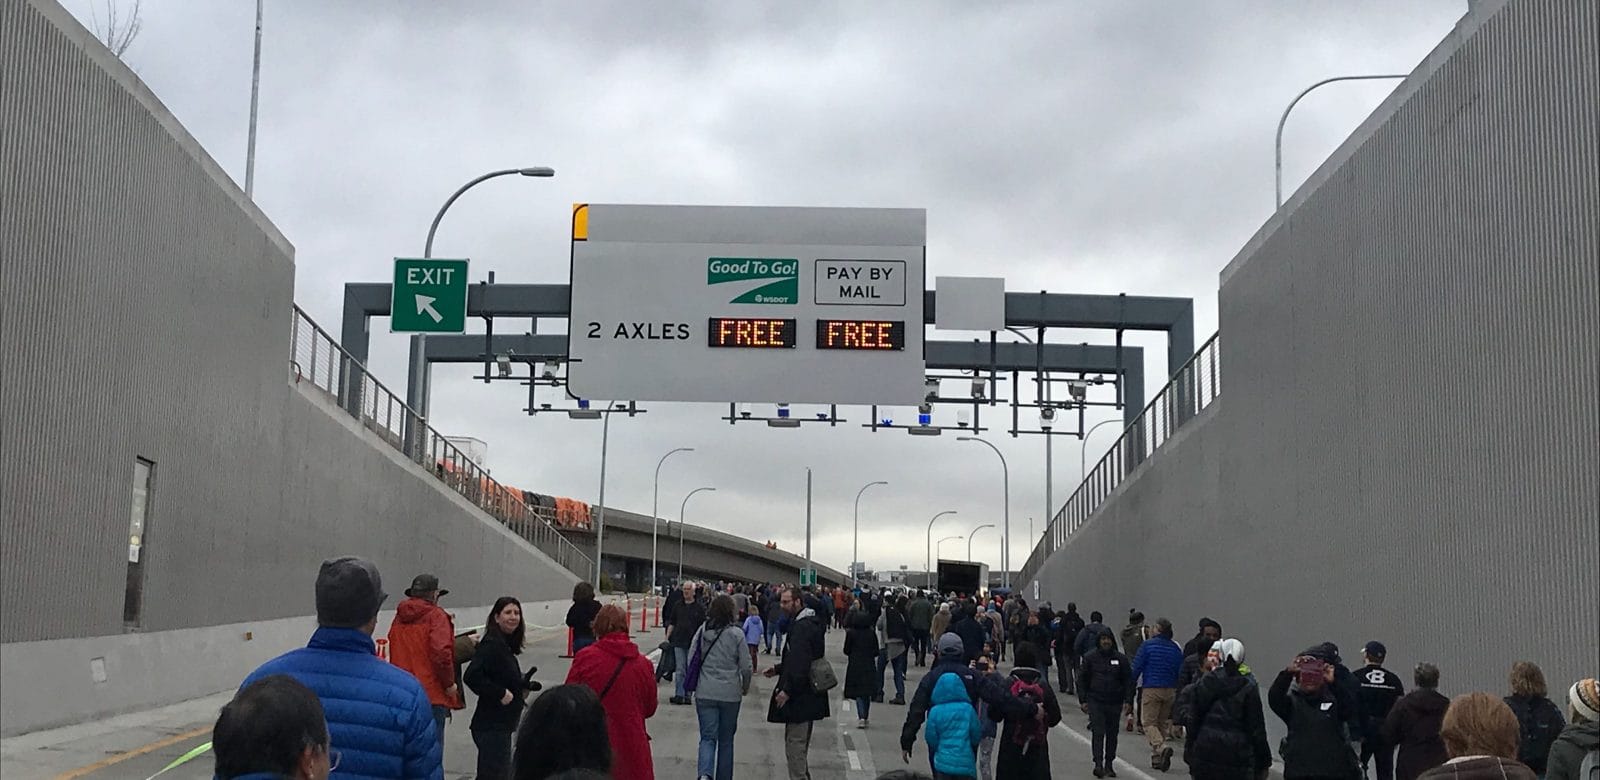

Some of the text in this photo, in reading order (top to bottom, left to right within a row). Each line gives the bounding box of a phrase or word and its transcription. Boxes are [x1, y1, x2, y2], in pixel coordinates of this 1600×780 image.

[710, 260, 797, 275] Good To Go!
[827, 267, 893, 281] PAY BY
[407, 267, 455, 285] EXIT
[840, 285, 881, 298] MAIL
[763, 296, 789, 304] WSDOT
[587, 321, 690, 340] 2 AXLES
[720, 320, 784, 345] FREE
[828, 322, 893, 347] FREE
